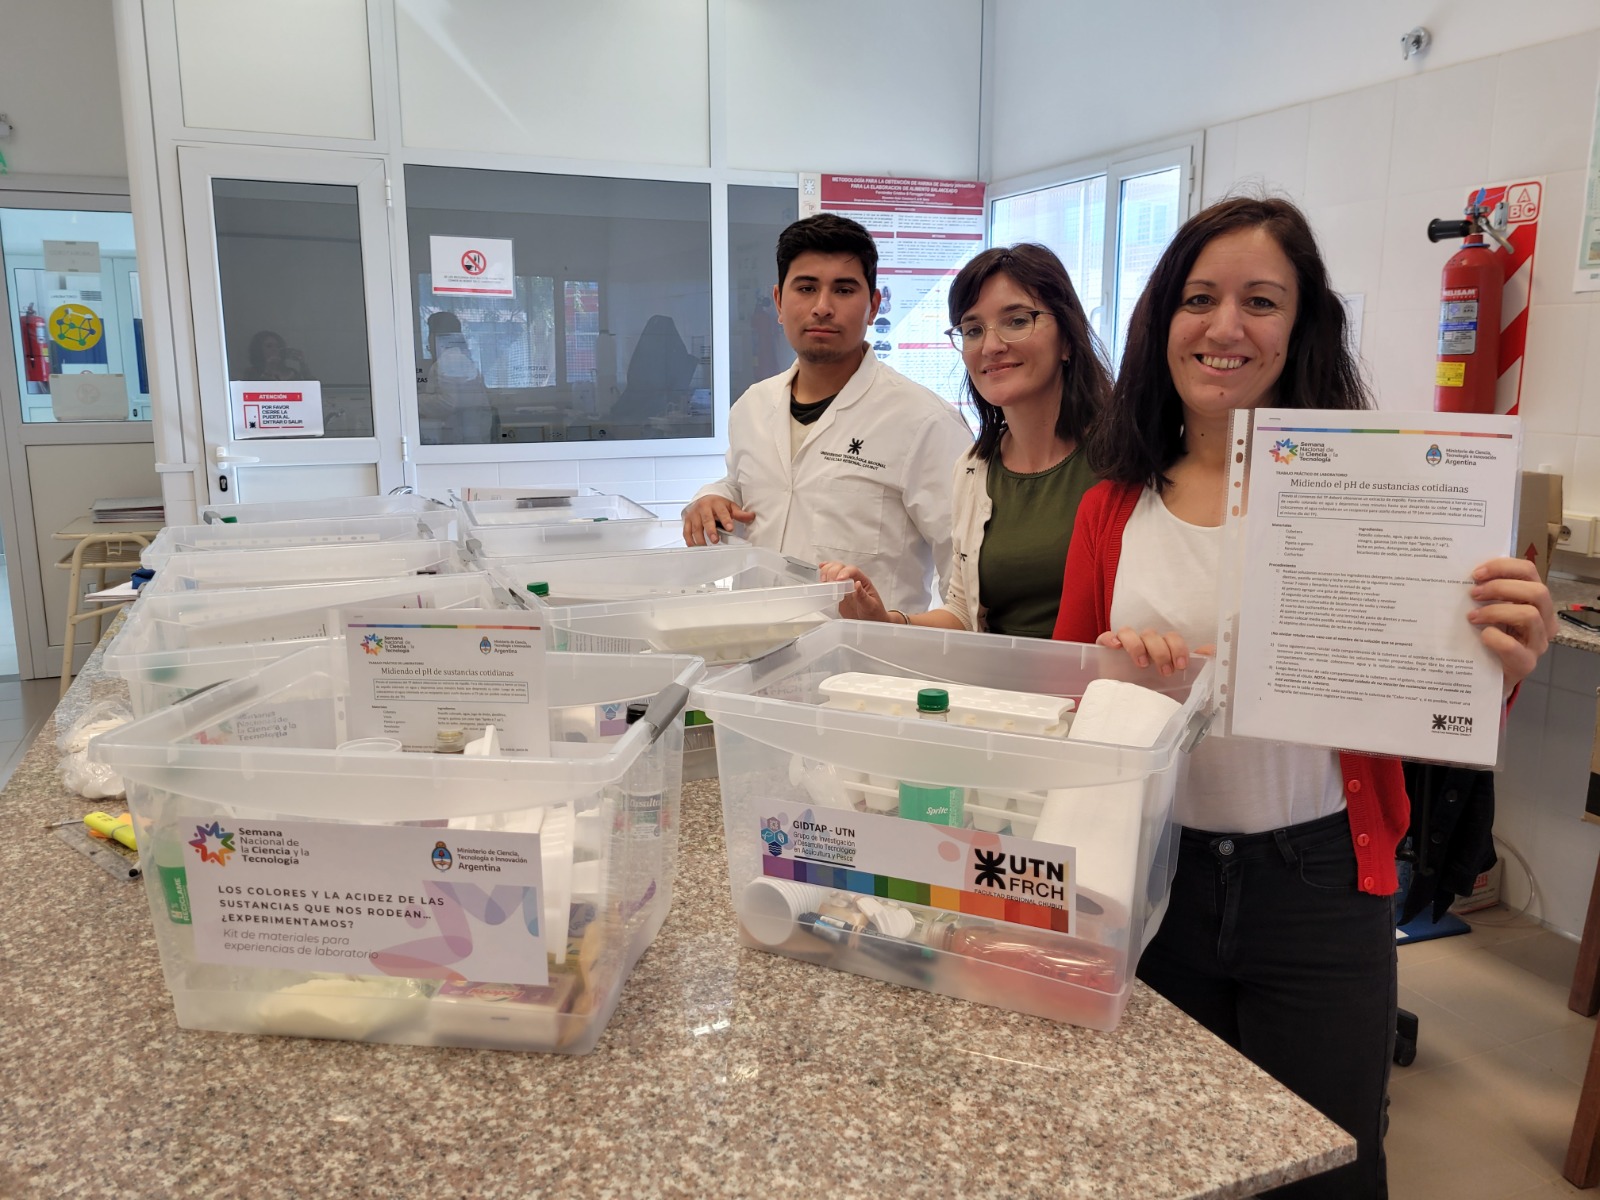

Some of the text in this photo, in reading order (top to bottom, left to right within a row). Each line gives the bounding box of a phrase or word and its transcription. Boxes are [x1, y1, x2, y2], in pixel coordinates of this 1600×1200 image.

[1290, 479, 1332, 488] Midiendo
[1334, 480, 1342, 488] el
[1344, 482, 1356, 490] pH
[1372, 482, 1420, 491] sustancias
[1422, 484, 1468, 493] cotidianas
[382, 667, 414, 675] Midiendo
[422, 668, 432, 676] pH
[1448, 716, 1472, 725] UTN
[1448, 724, 1472, 733] FRCH
[926, 806, 948, 816] Sprite
[239, 828, 282, 837] Semana
[793, 820, 827, 832] GIDTAP
[835, 827, 854, 838] UTN
[240, 837, 284, 846] Nacional
[794, 832, 809, 840] Grupo
[820, 836, 854, 846] Investigación
[252, 846, 290, 855] Ciencia
[293, 849, 298, 857] y
[301, 848, 310, 856] la
[798, 840, 823, 850] Desarrollo
[825, 844, 856, 854] Tecnológico
[242, 855, 299, 865] Tecnología
[458, 854, 488, 862] Tecnología
[802, 848, 830, 859] Acuicultura
[837, 854, 852, 862] Pesca
[458, 862, 501, 872] Argentina
[1010, 854, 1064, 882] UTN
[218, 886, 242, 894] LOS
[248, 887, 306, 898] COLORES
[325, 891, 340, 900] LA
[346, 892, 393, 902] ACIDEZ
[398, 896, 415, 904] DE
[420, 896, 444, 906] LAS
[1010, 878, 1064, 900] FRCH
[174, 877, 190, 921] RECICLAME
[974, 888, 1063, 910] FACULTAD REGIONAL CHUBUT
[220, 900, 299, 911] SUSTANCIAS
[304, 904, 330, 914] QUE
[336, 906, 362, 915] NOS
[222, 914, 354, 928] ¿EXPERIMENTAMOS?
[224, 928, 349, 949] Kit de materiales para
[224, 942, 378, 960] experiencias de laboratorio
